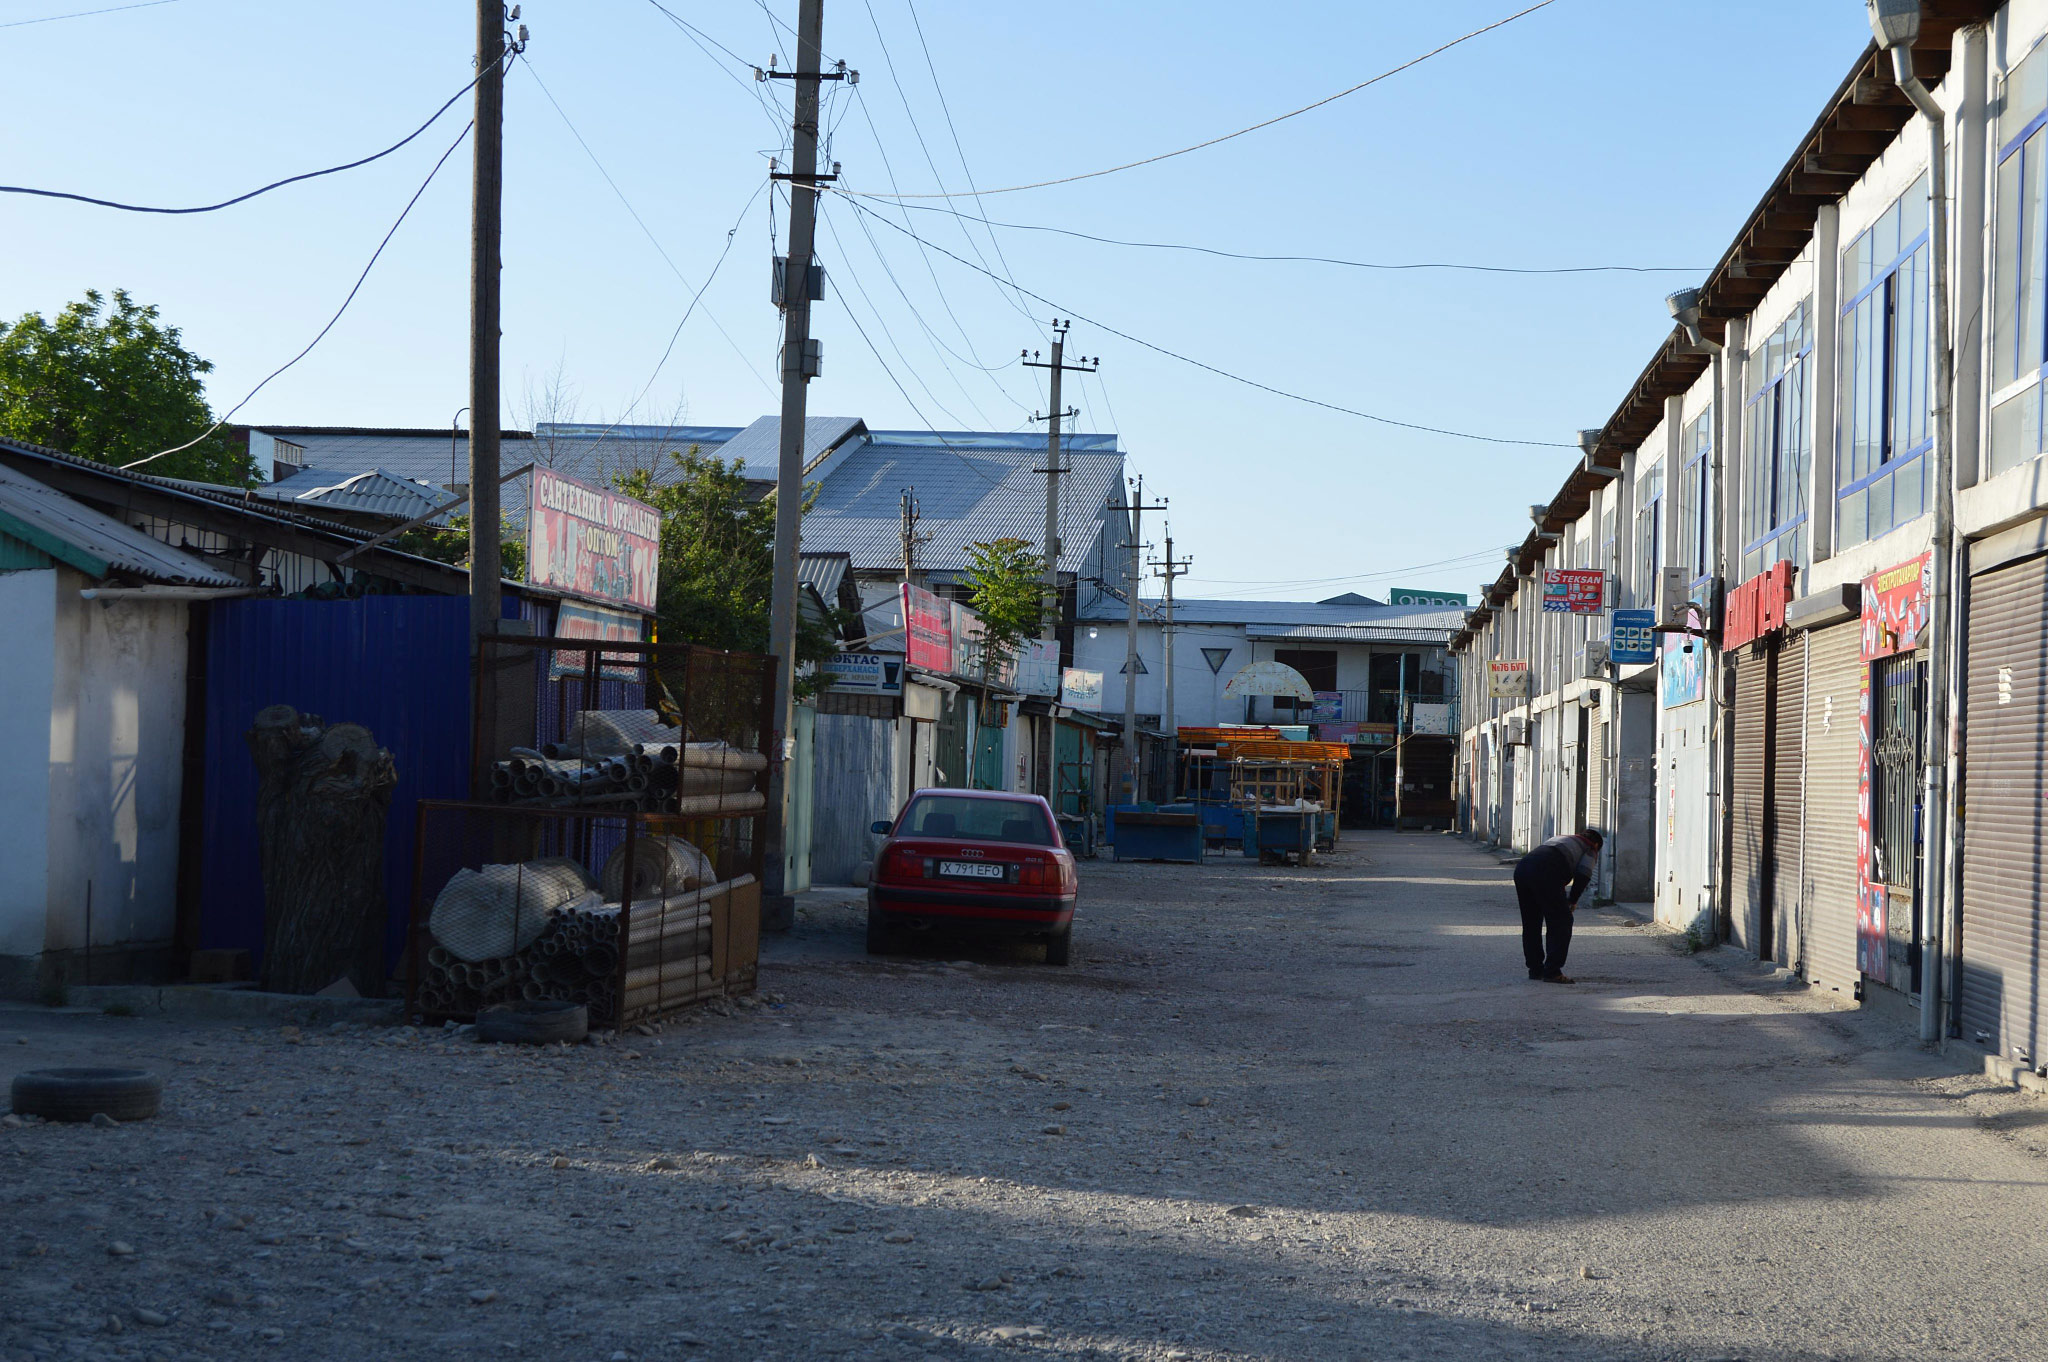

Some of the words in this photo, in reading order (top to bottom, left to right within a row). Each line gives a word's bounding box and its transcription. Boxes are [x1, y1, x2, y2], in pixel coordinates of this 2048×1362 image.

[540, 474, 608, 527] САНТЕХНИКА
[586, 525, 618, 558] ОПТОМ
[1562, 575, 1601, 584] TEKSAN
[1491, 663, 1509, 672] №76
[943, 862, 951, 873] X
[955, 863, 974, 875] 791
[977, 865, 1000, 876] EFO
